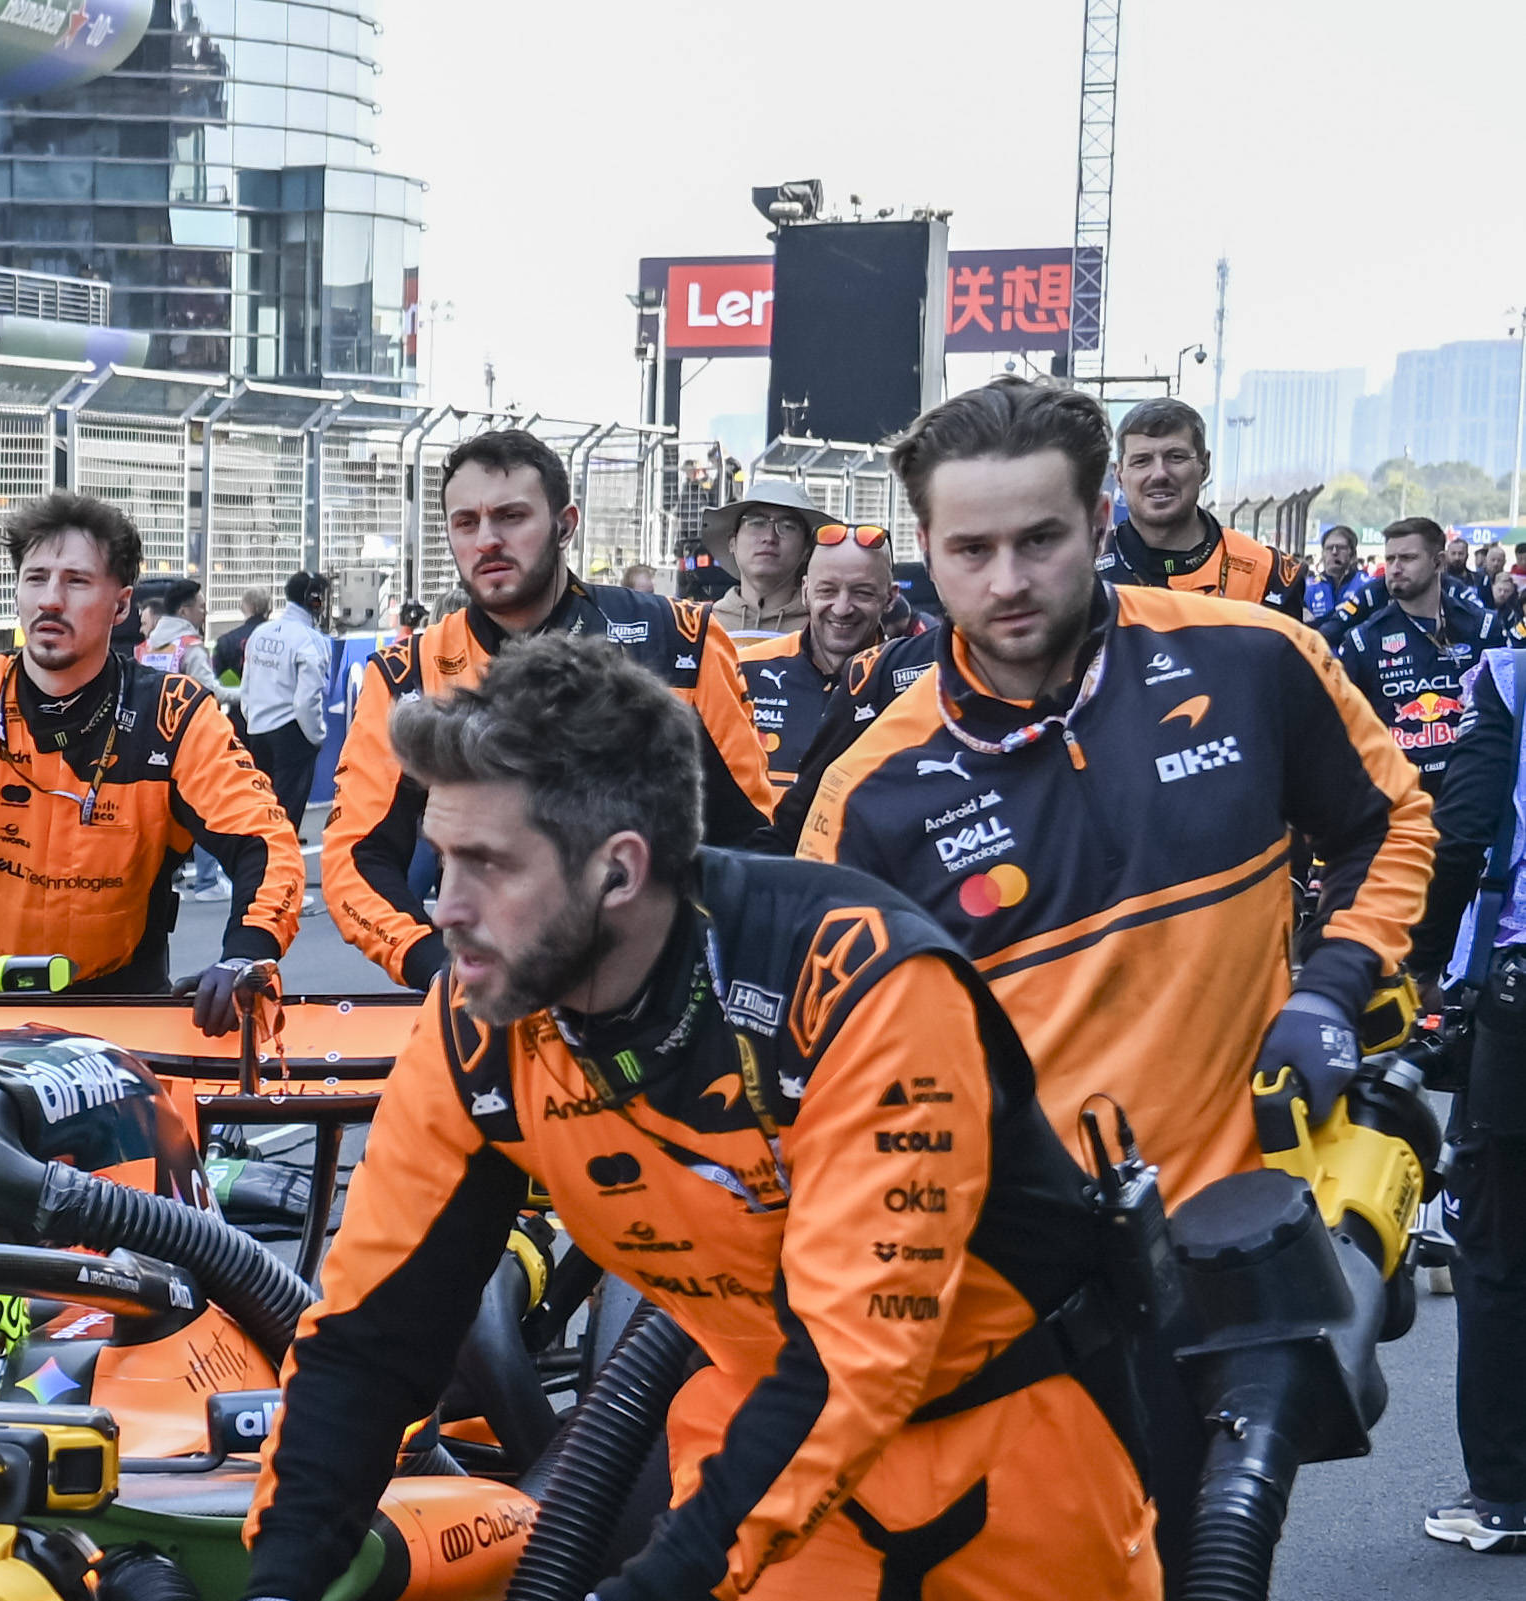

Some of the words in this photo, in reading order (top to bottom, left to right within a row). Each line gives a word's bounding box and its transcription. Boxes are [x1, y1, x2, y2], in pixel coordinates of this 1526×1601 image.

[1380, 668, 1414, 680] CARLYLE
[1382, 675, 1460, 698] ORACL
[754, 710, 784, 722] DELL
[1390, 723, 1430, 749] Red
[1155, 735, 1242, 783] OKX
[93, 811, 115, 821] SCO
[925, 799, 979, 833] Android
[935, 816, 1011, 863] DELL
[944, 838, 1015, 873] Technologies
[24, 866, 123, 892] Technologies
[735, 986, 774, 1017] Hilton
